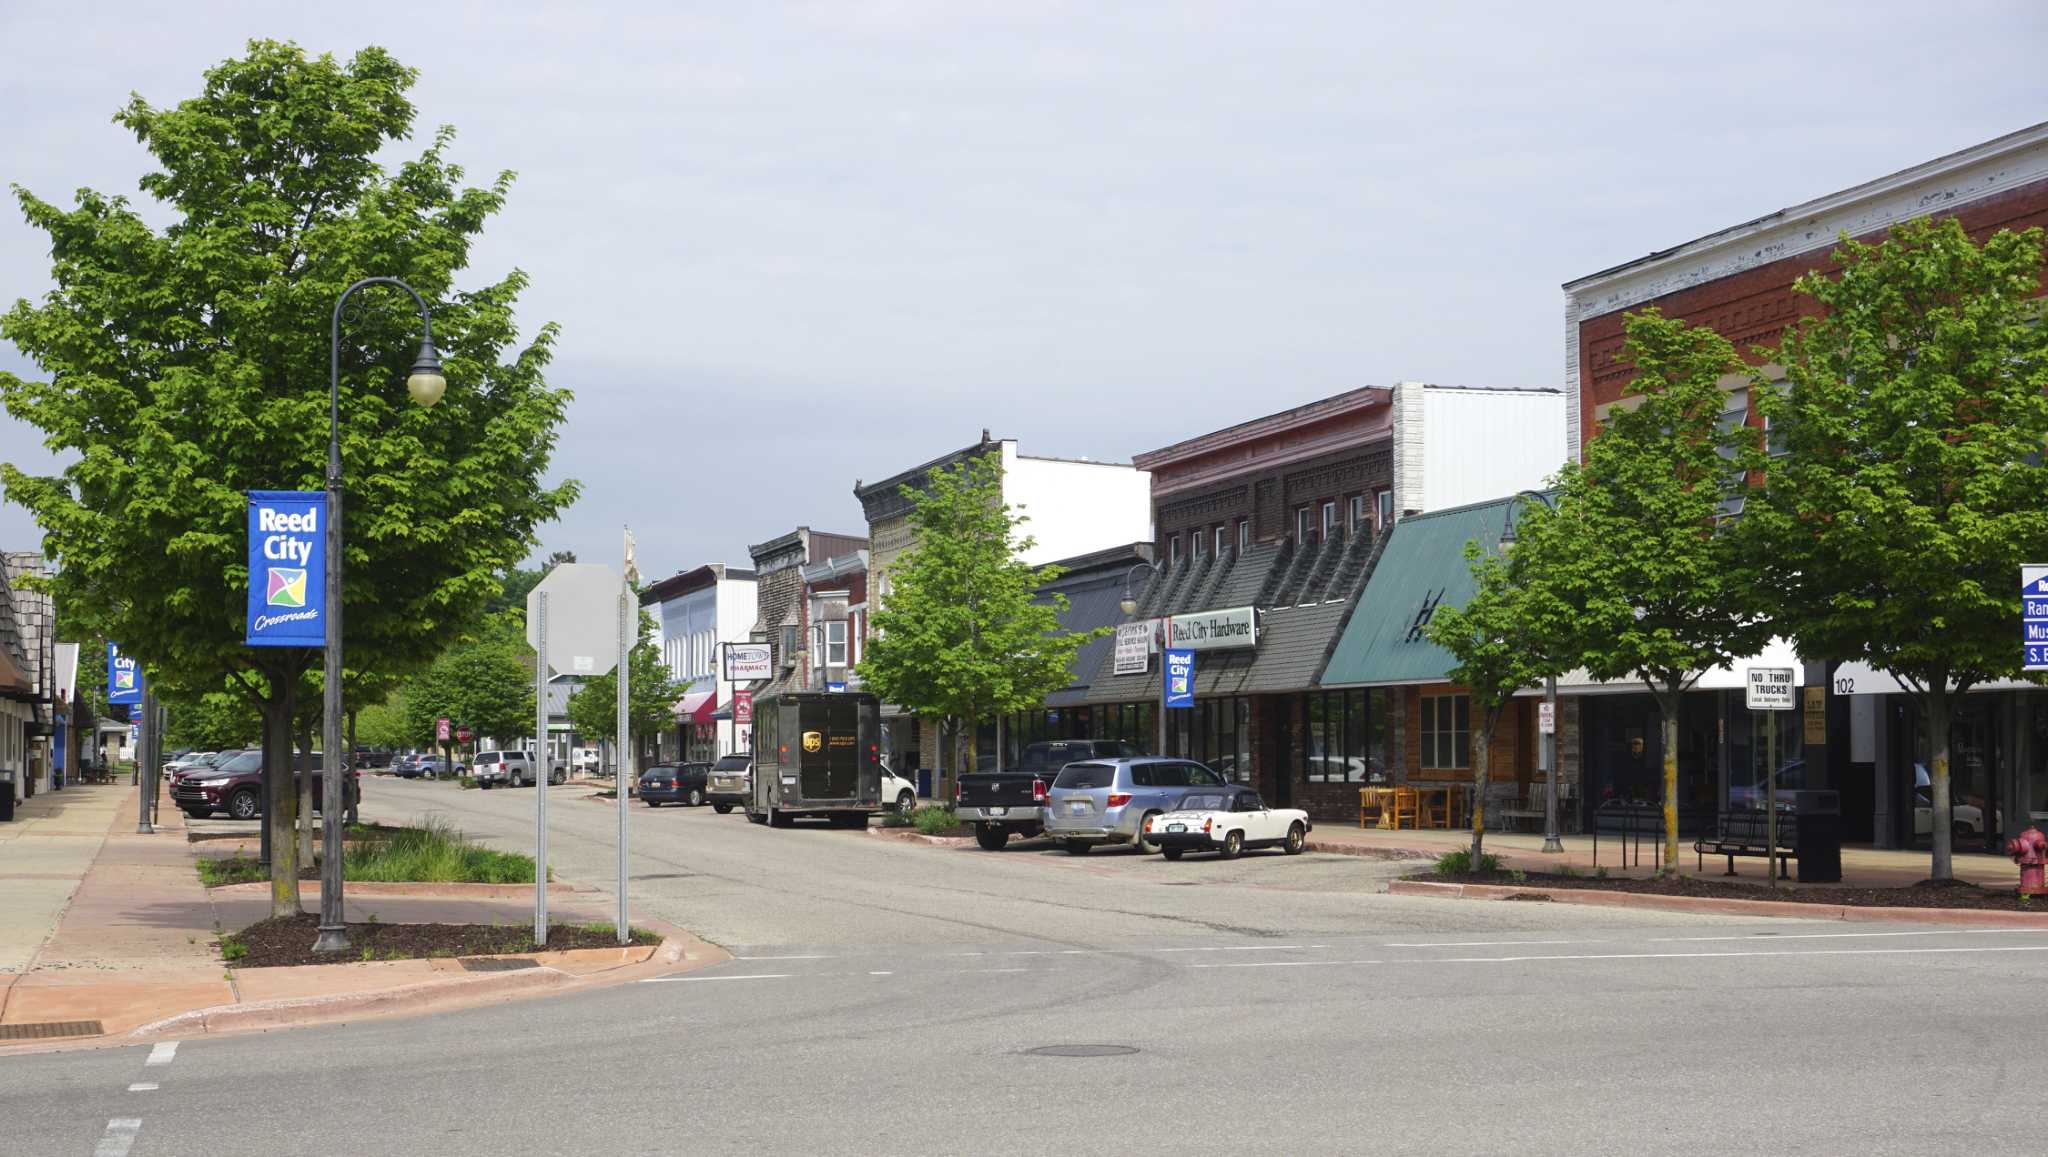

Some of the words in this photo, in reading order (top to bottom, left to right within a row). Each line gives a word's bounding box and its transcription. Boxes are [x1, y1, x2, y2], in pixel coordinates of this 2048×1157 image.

[259, 507, 317, 532] Reed
[264, 535, 312, 566] City
[254, 608, 318, 631] Crossroads
[1173, 622, 1191, 641] Reed
[1193, 620, 1208, 642] City
[1210, 616, 1250, 638] Hardware
[114, 658, 135, 671] City
[1169, 654, 1191, 664] Reed
[1171, 665, 1189, 678] City
[1751, 673, 1763, 682] NO
[1768, 673, 1790, 683] THRU
[1756, 685, 1787, 694] TRUCKS
[1835, 678, 1854, 693] 102
